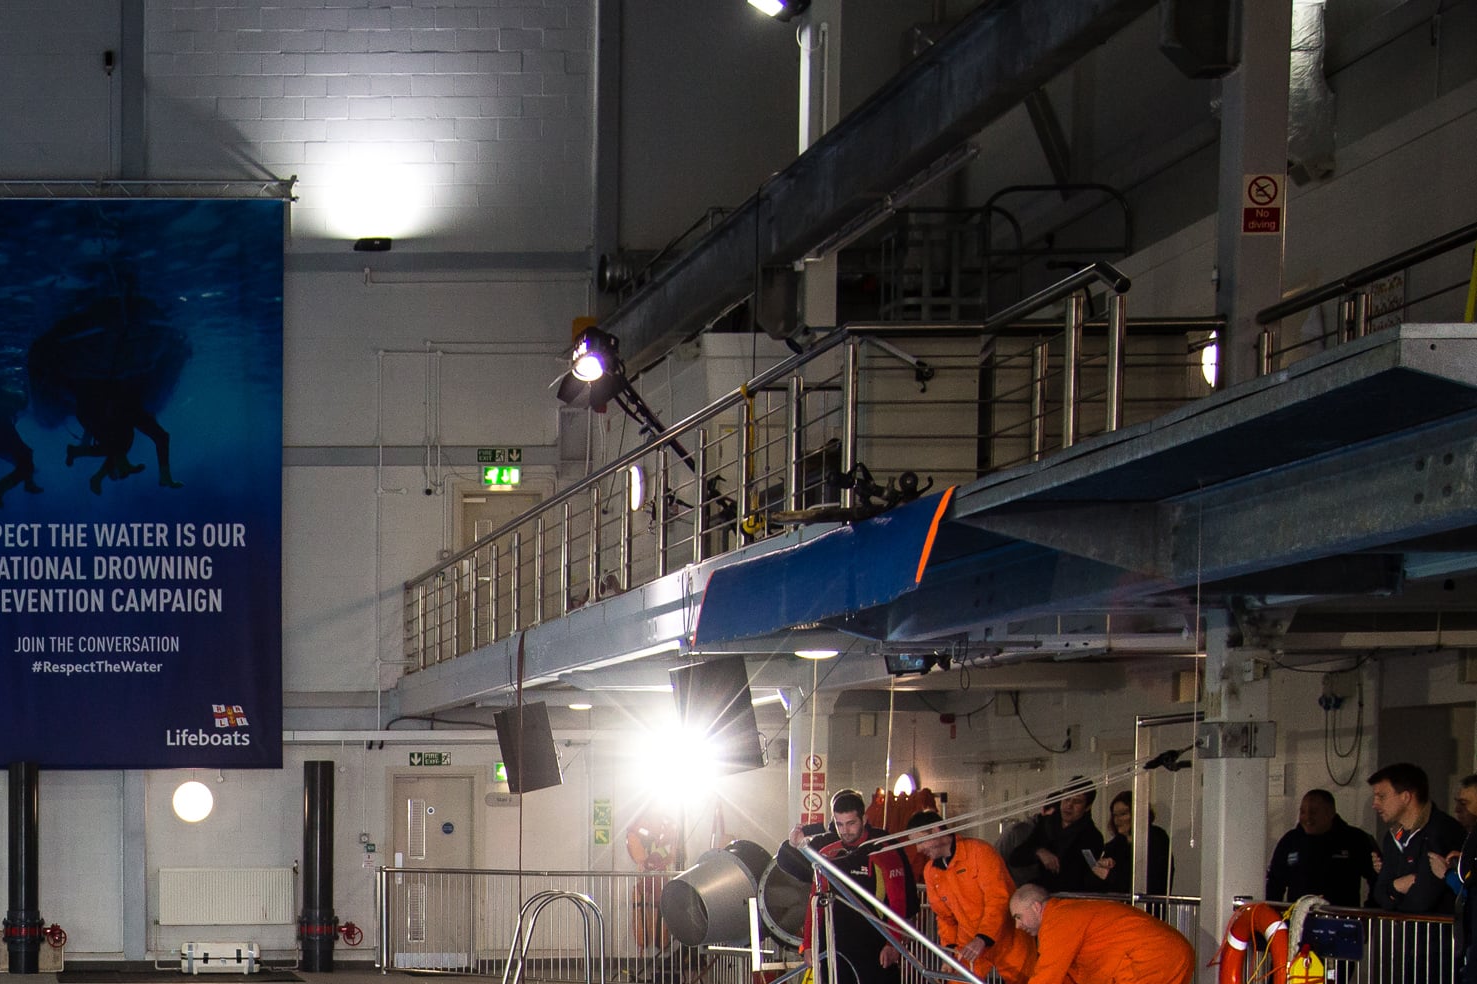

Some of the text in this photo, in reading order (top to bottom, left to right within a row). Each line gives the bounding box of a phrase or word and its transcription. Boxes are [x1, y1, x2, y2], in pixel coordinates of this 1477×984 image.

[1255, 208, 1270, 218] No
[1248, 220, 1276, 231] diving
[47, 523, 88, 547] THE
[93, 523, 169, 547] WATER
[176, 522, 196, 547] IS
[202, 523, 246, 548] OUR
[93, 555, 213, 580] DROWNING
[111, 588, 222, 613] CAMPAIGN
[14, 636, 179, 653] JOIN THE CONVERSATION
[31, 660, 163, 677] #RespectTheWater
[166, 728, 250, 746] Lifeboats
